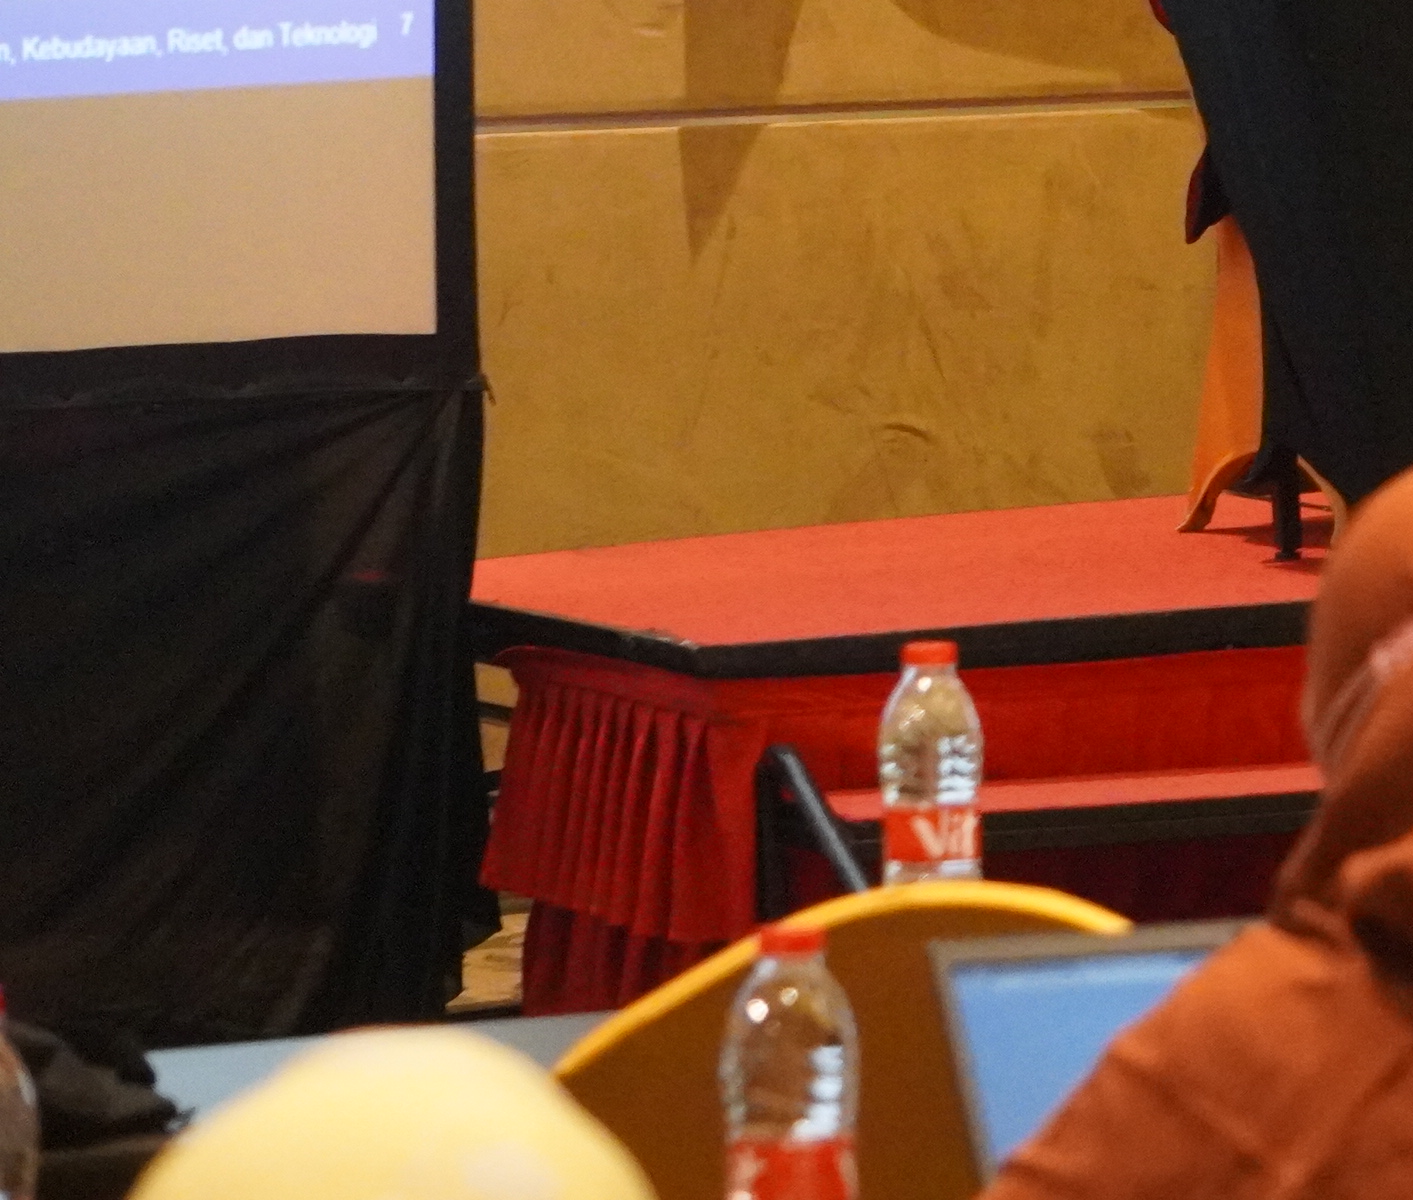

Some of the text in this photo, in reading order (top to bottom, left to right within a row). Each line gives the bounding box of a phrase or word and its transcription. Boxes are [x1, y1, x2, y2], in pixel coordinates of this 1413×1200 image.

[22, 34, 163, 63] Kebudayaan,
[233, 24, 274, 51] dan
[278, 16, 378, 49] Teknologi
[401, 10, 414, 36] 7
